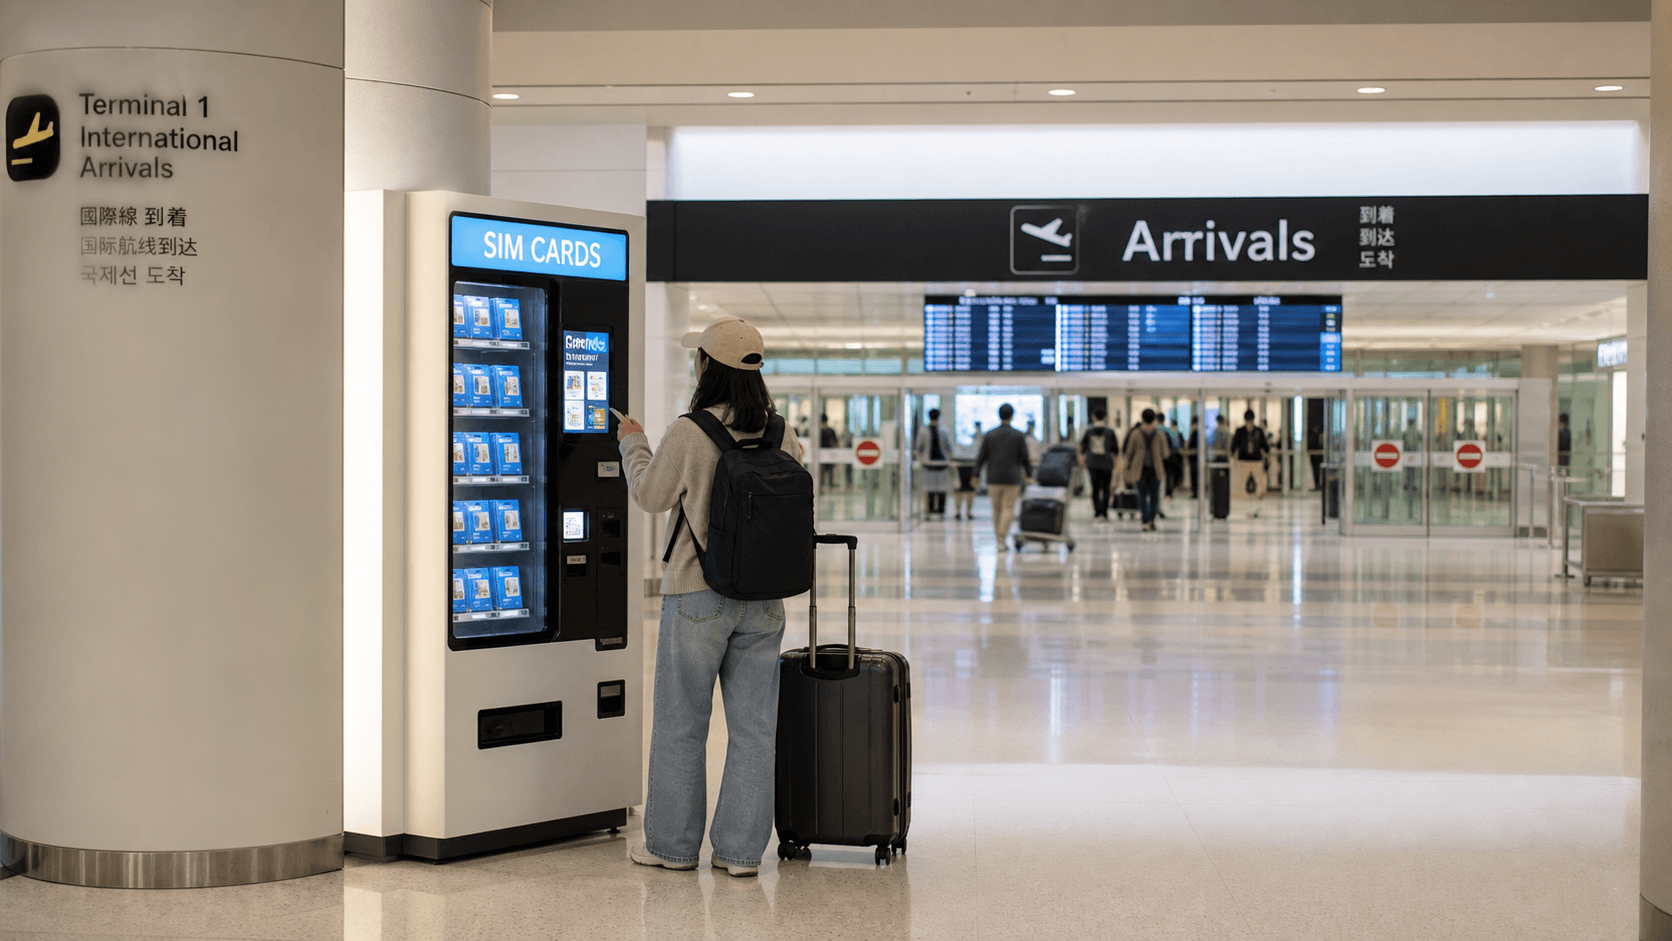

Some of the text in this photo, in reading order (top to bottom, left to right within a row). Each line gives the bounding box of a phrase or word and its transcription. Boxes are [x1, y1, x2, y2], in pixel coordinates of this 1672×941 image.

[79, 93, 208, 118] Terminal 1
[80, 126, 238, 152] International
[80, 156, 174, 179] Arrivals
[80, 206, 187, 227] 國際線 到着
[1122, 218, 1316, 262] Arrivals
[1359, 227, 1395, 247] 到达
[483, 231, 601, 268] SIM CARDS
[80, 265, 186, 286] 국제선 도착
